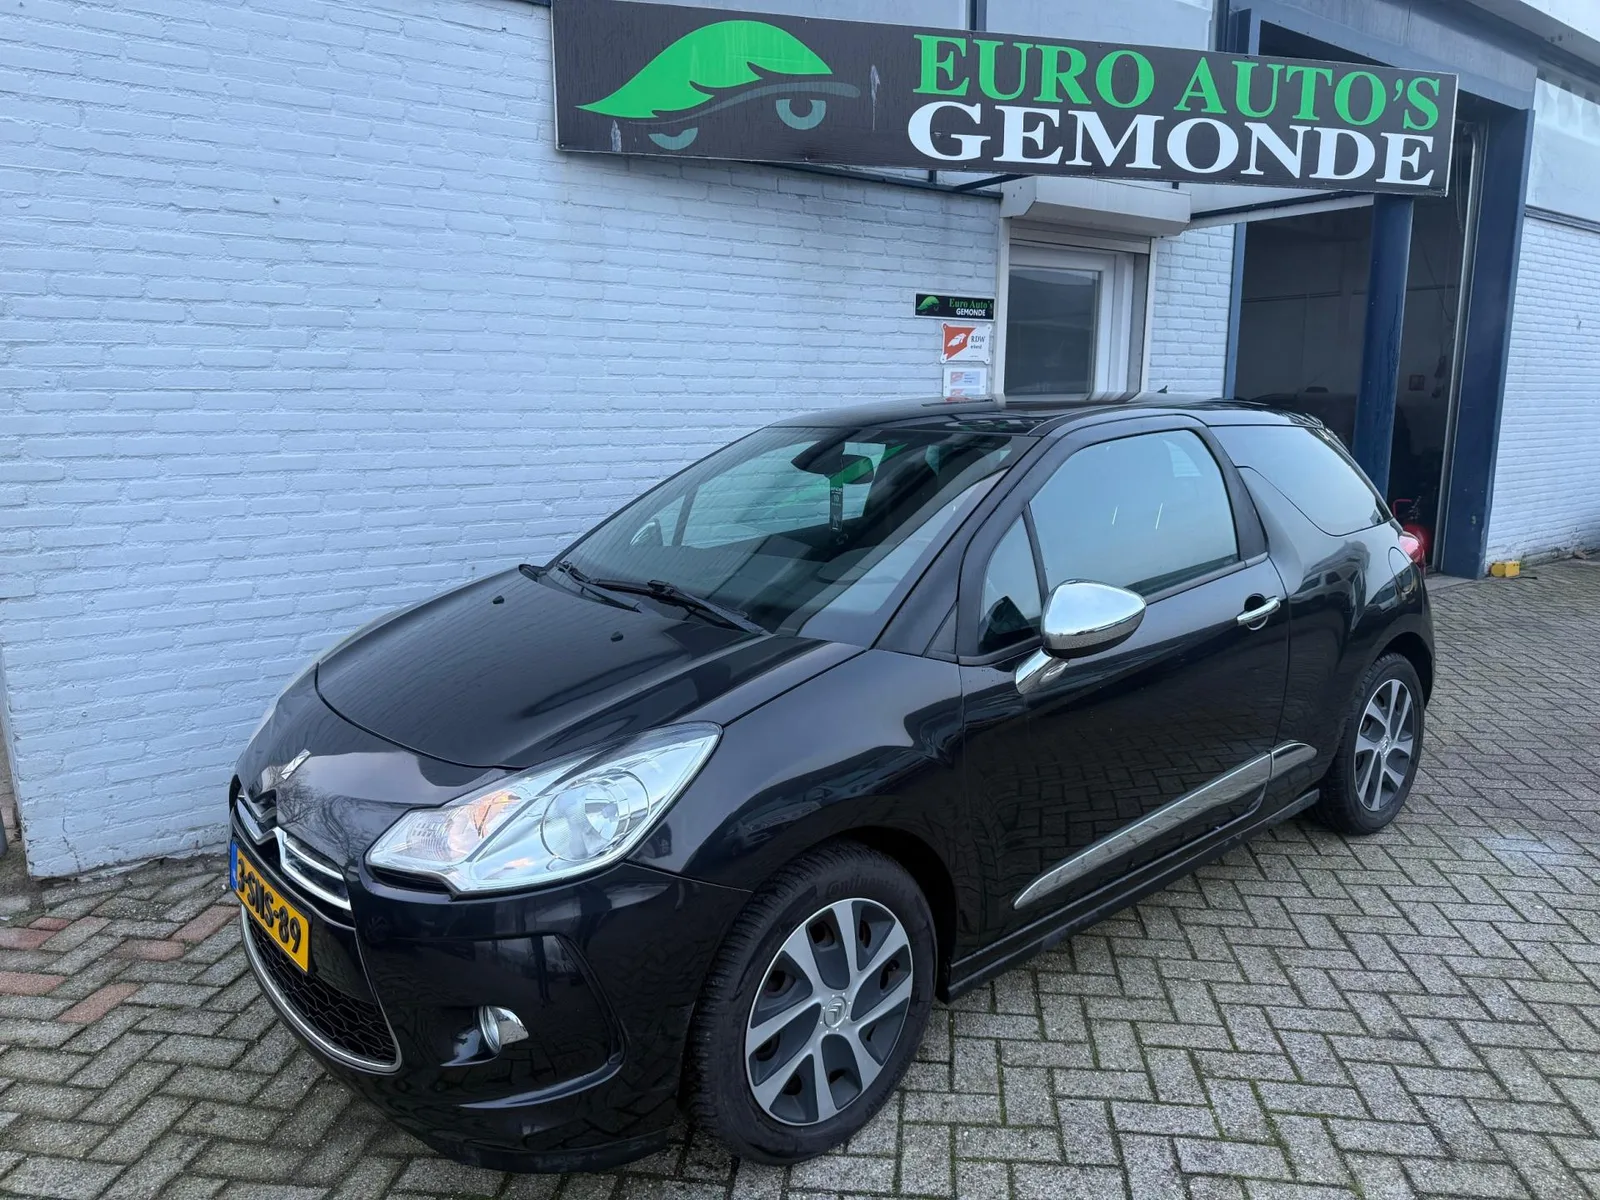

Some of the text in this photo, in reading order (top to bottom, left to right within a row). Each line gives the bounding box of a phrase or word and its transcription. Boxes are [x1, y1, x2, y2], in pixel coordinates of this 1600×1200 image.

[912, 34, 1441, 131] EURO AUTO'S
[907, 101, 1436, 186] GEMONDE
[949, 298, 968, 308] Euro
[956, 307, 986, 317] GEMONDE
[238, 858, 302, 954] 3-SNS-89
